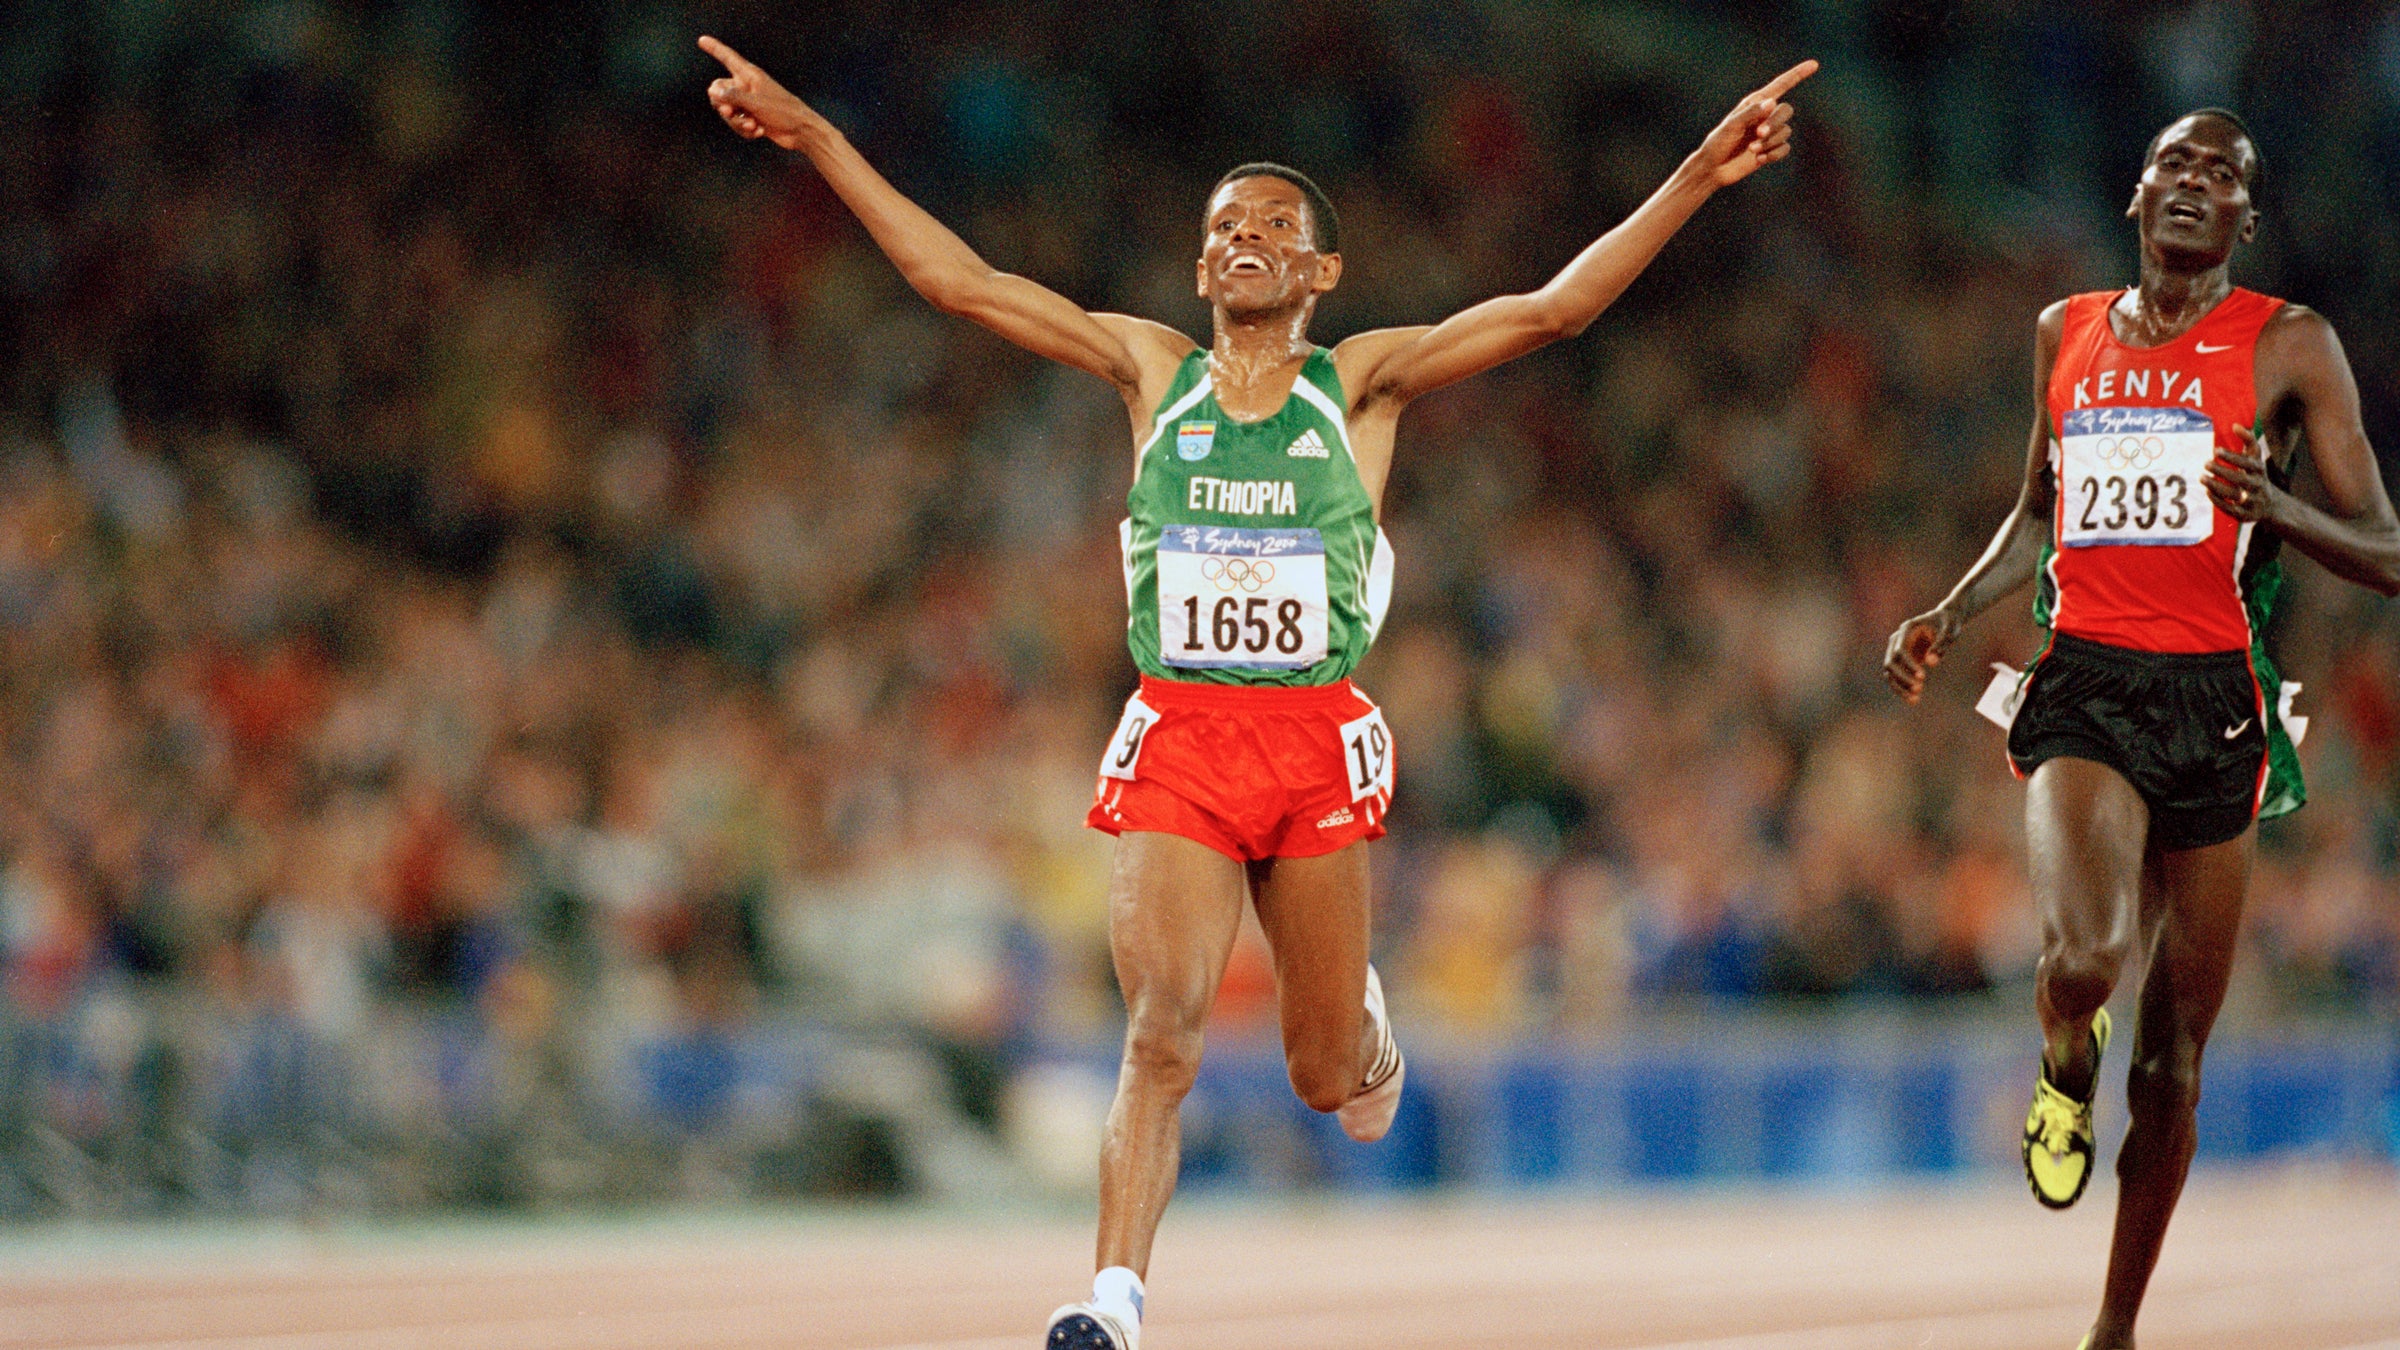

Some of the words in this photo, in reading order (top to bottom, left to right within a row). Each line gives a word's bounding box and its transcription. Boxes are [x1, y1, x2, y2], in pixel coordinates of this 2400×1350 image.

[2074, 369, 2203, 409] KENYA
[2099, 409, 2152, 433] Sydney
[2152, 413, 2188, 431] 2000
[1287, 445, 1330, 459] adidas
[1189, 476, 1297, 516] ETHIOPIA
[2080, 474, 2189, 531] 2393
[1204, 528, 1262, 557] Sydney
[1261, 536, 1298, 554] 2000
[1183, 595, 1304, 655] 1658
[1115, 717, 1147, 769] 9
[1351, 722, 1387, 791] 19
[1316, 813, 1355, 829] adidas
